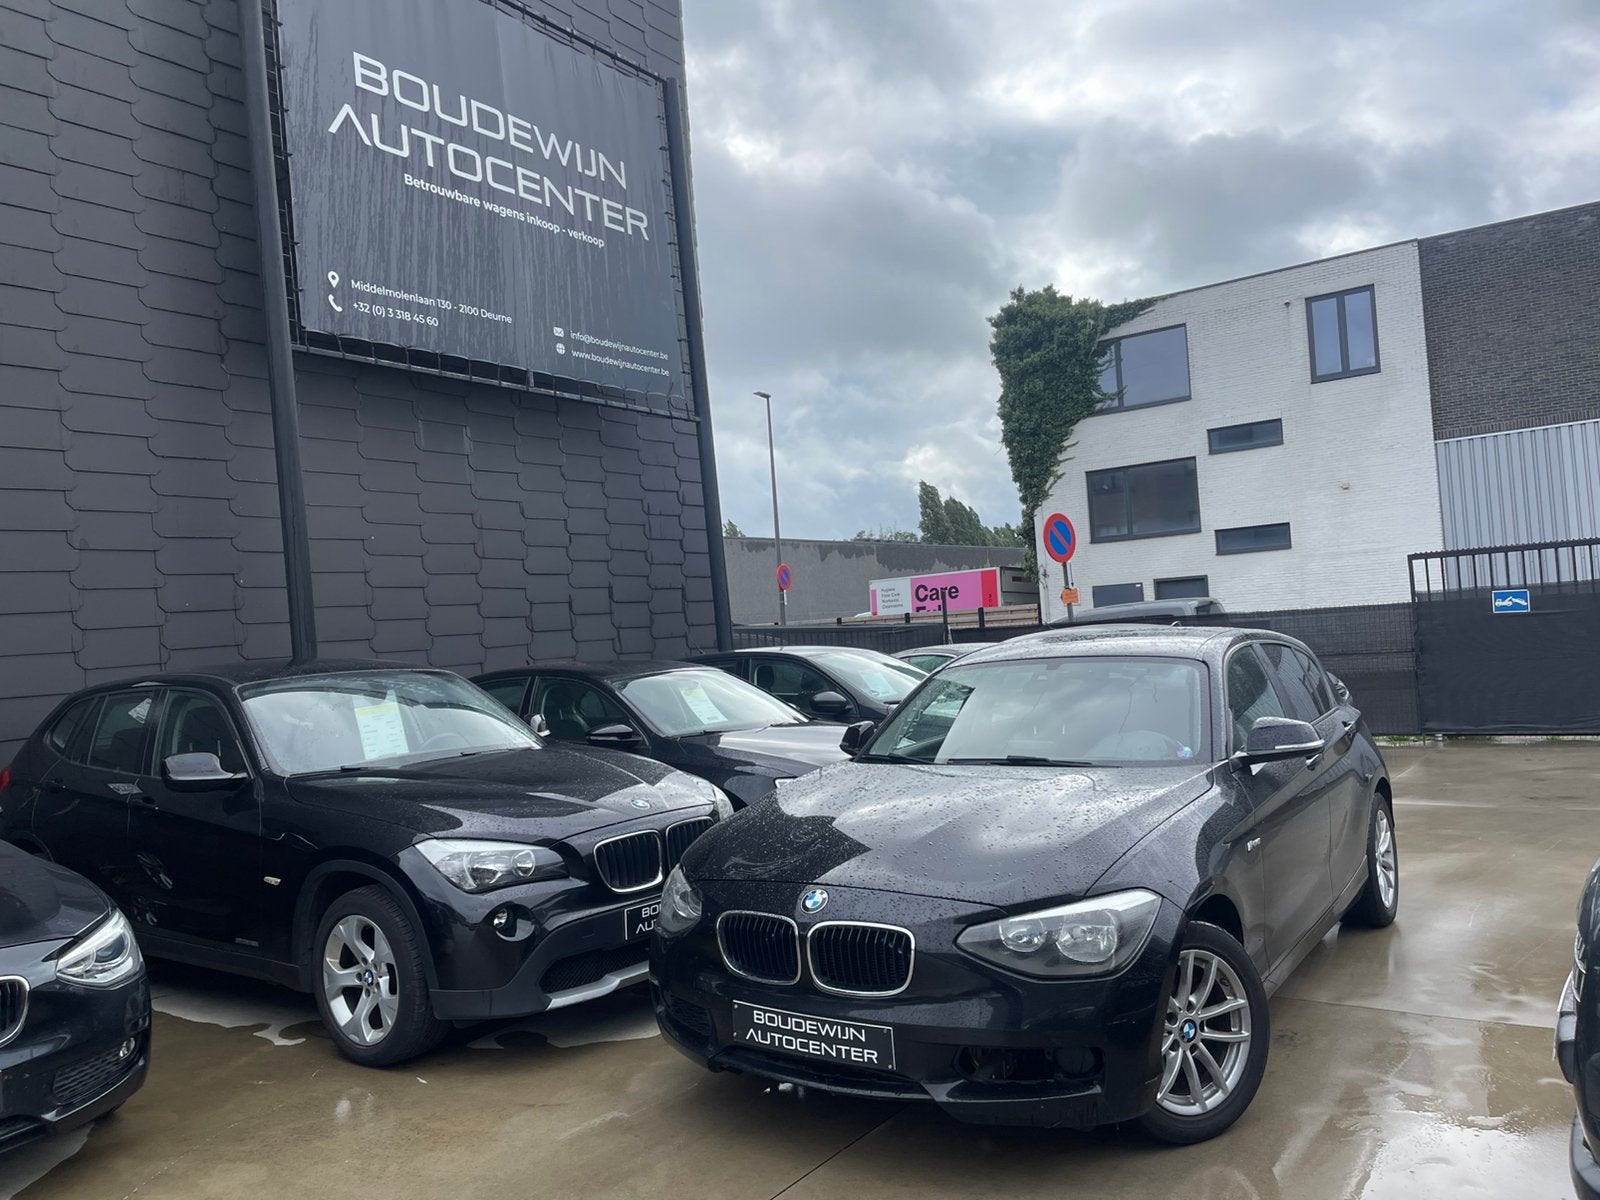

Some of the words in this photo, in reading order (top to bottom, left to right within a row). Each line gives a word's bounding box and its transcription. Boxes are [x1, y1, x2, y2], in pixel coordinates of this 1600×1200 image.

[353, 51, 627, 190] BOUDEWIJN
[328, 103, 650, 241] AUTOCENTER
[404, 173, 481, 207] Betrouwbare
[482, 199, 525, 221] wagens
[526, 212, 560, 234] inkoop
[567, 228, 605, 248] verkoop
[351, 279, 436, 307] Middelmolenlaan
[437, 298, 452, 310] 130
[459, 304, 479, 316] 2100
[480, 308, 513, 324] Deurne
[352, 301, 370, 314] +32
[372, 304, 386, 318] (0)
[387, 307, 394, 317] 3
[395, 309, 411, 321] 318
[413, 313, 425, 324] 45
[426, 316, 439, 327] 60
[570, 330, 669, 360] info@boudewijnautocenter.be
[571, 350, 670, 377] www.boudewijnautocenter.be
[915, 584, 960, 602] Care
[642, 903, 662, 918] BO
[635, 919, 657, 934] AU
[753, 1010, 866, 1042] BOUDEWIJN
[745, 1028, 879, 1064] AUTOCENTER
